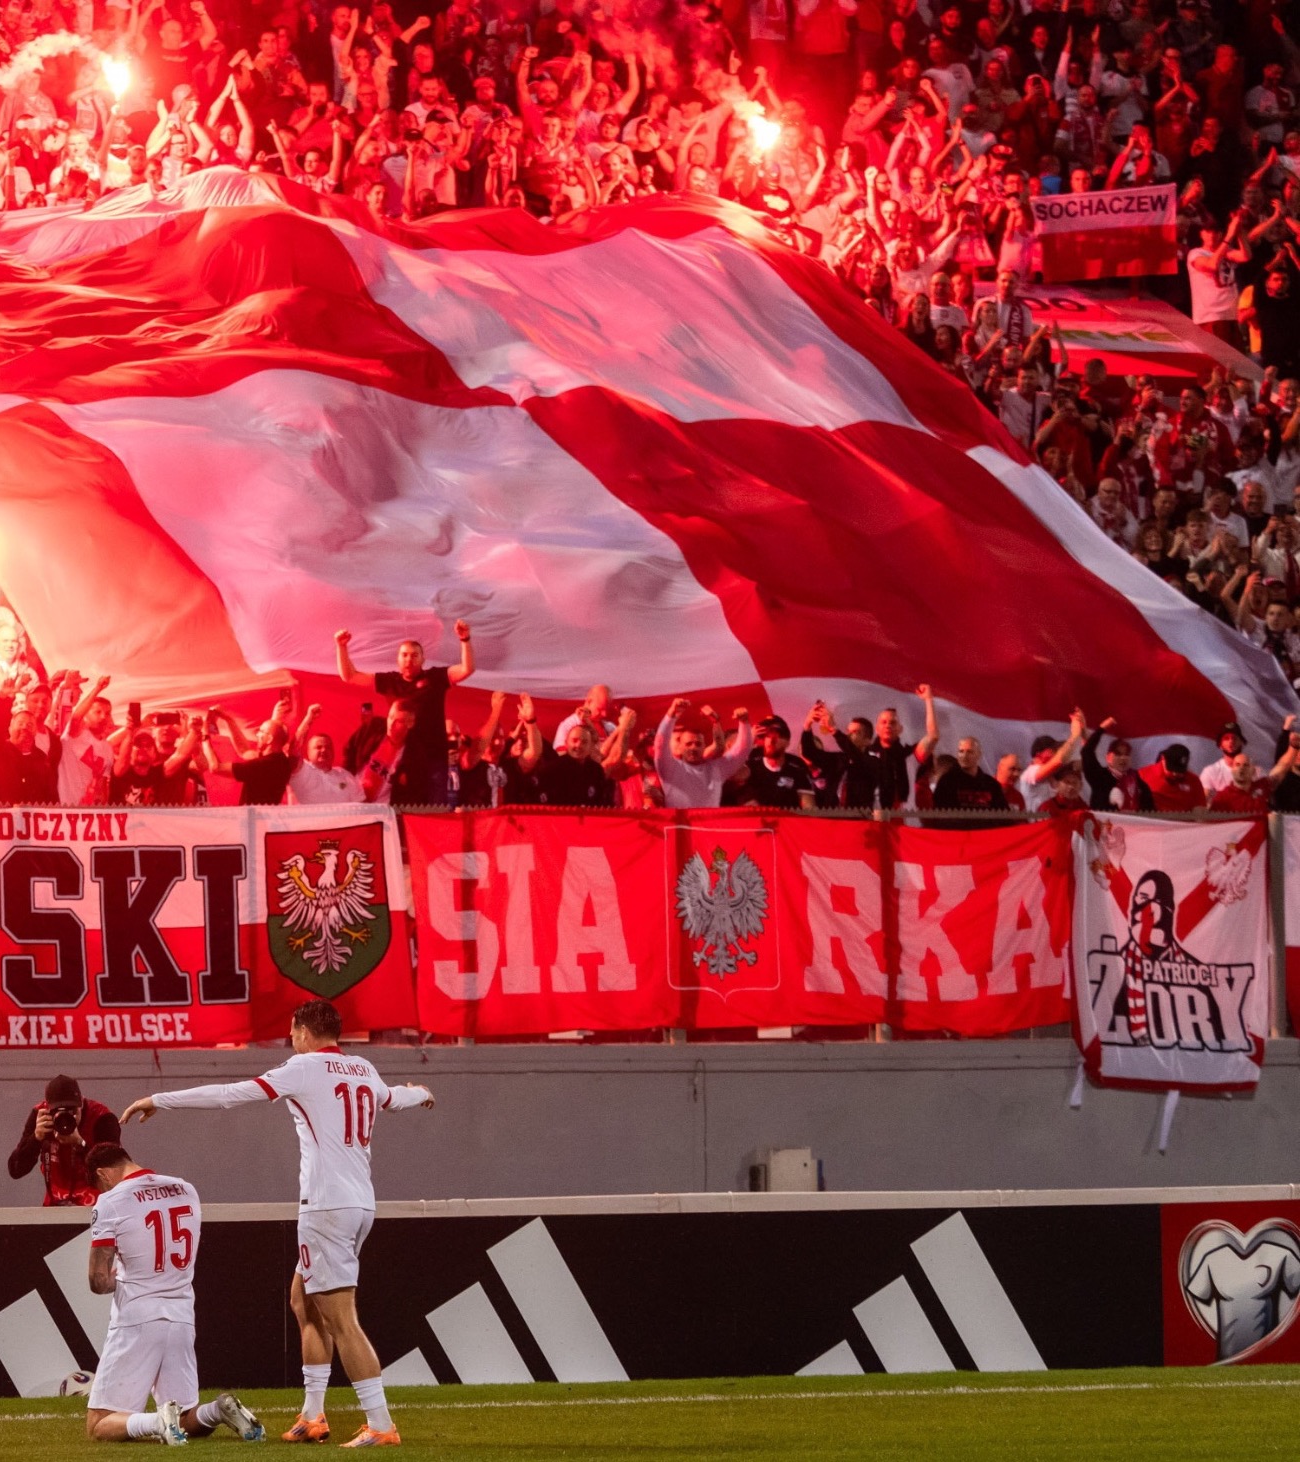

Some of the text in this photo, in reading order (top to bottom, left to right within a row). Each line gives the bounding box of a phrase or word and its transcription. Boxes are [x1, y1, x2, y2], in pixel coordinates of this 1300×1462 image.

[1035, 194, 1169, 221] SOCHACZEW
[1088, 934, 1254, 1053] ŻORY
[1143, 958, 1219, 988] PATRIOCI
[86, 1012, 192, 1044] POLSCE
[334, 1082, 375, 1149] 10
[145, 1205, 193, 1273] 15
